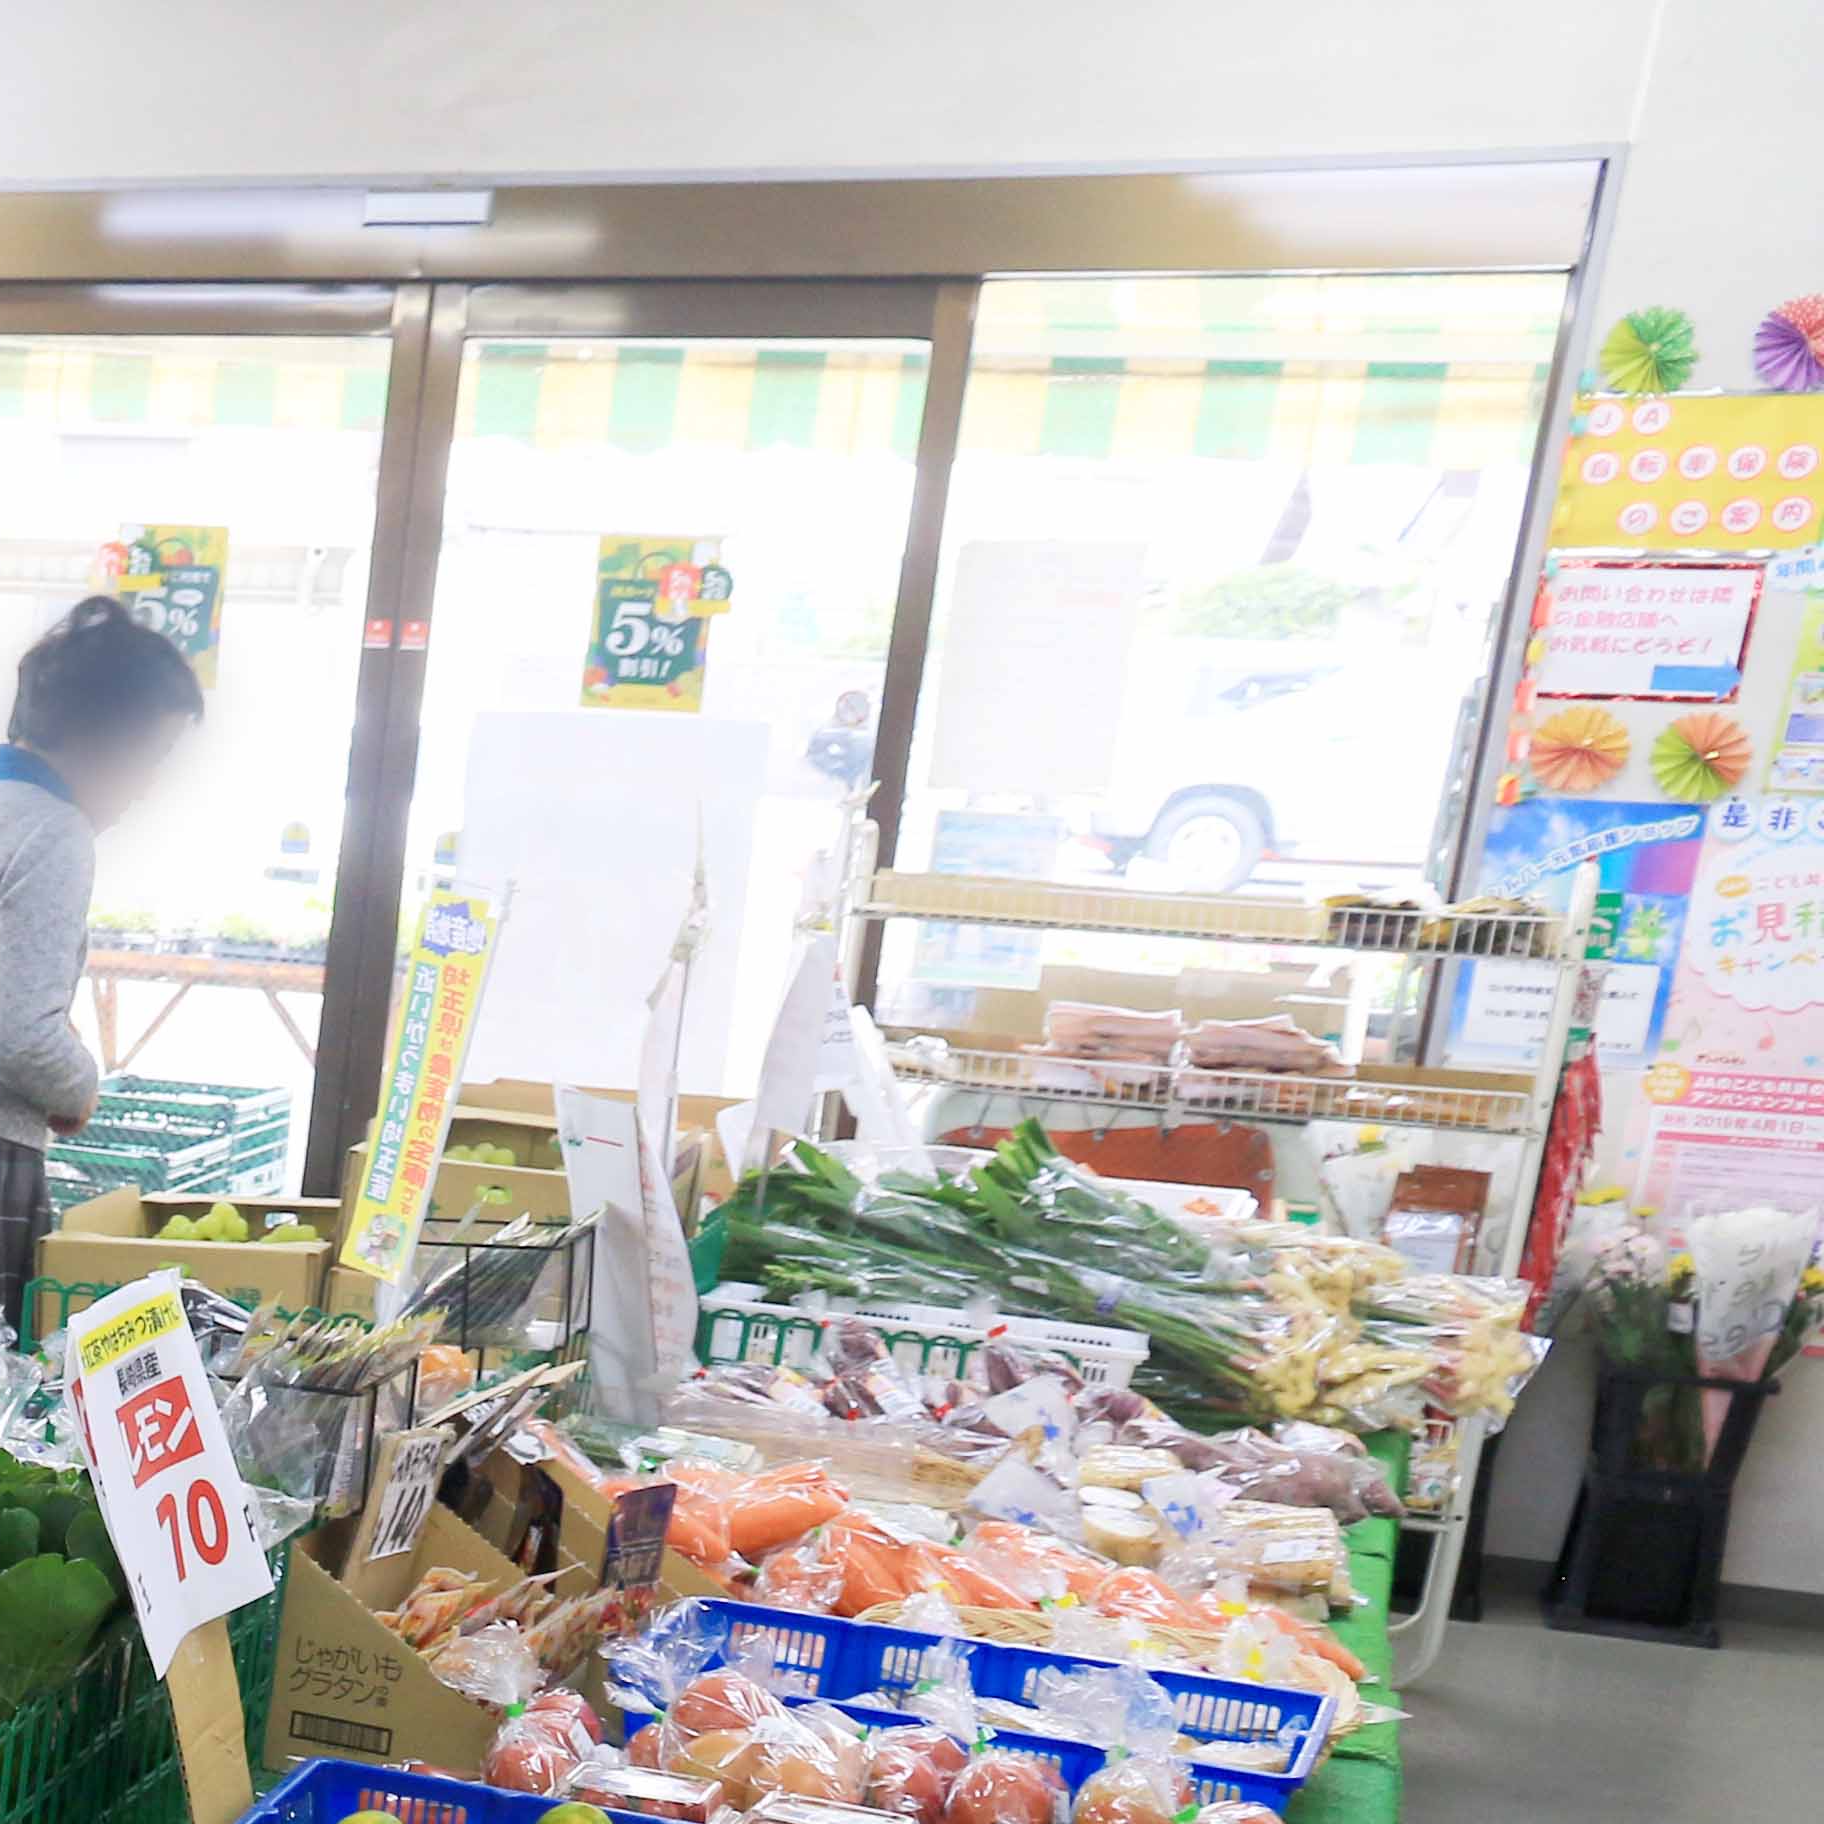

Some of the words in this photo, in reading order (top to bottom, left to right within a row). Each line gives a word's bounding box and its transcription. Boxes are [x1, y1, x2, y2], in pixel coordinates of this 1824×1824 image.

[605, 603, 686, 658] 5%
[117, 1396, 194, 1474] レモン
